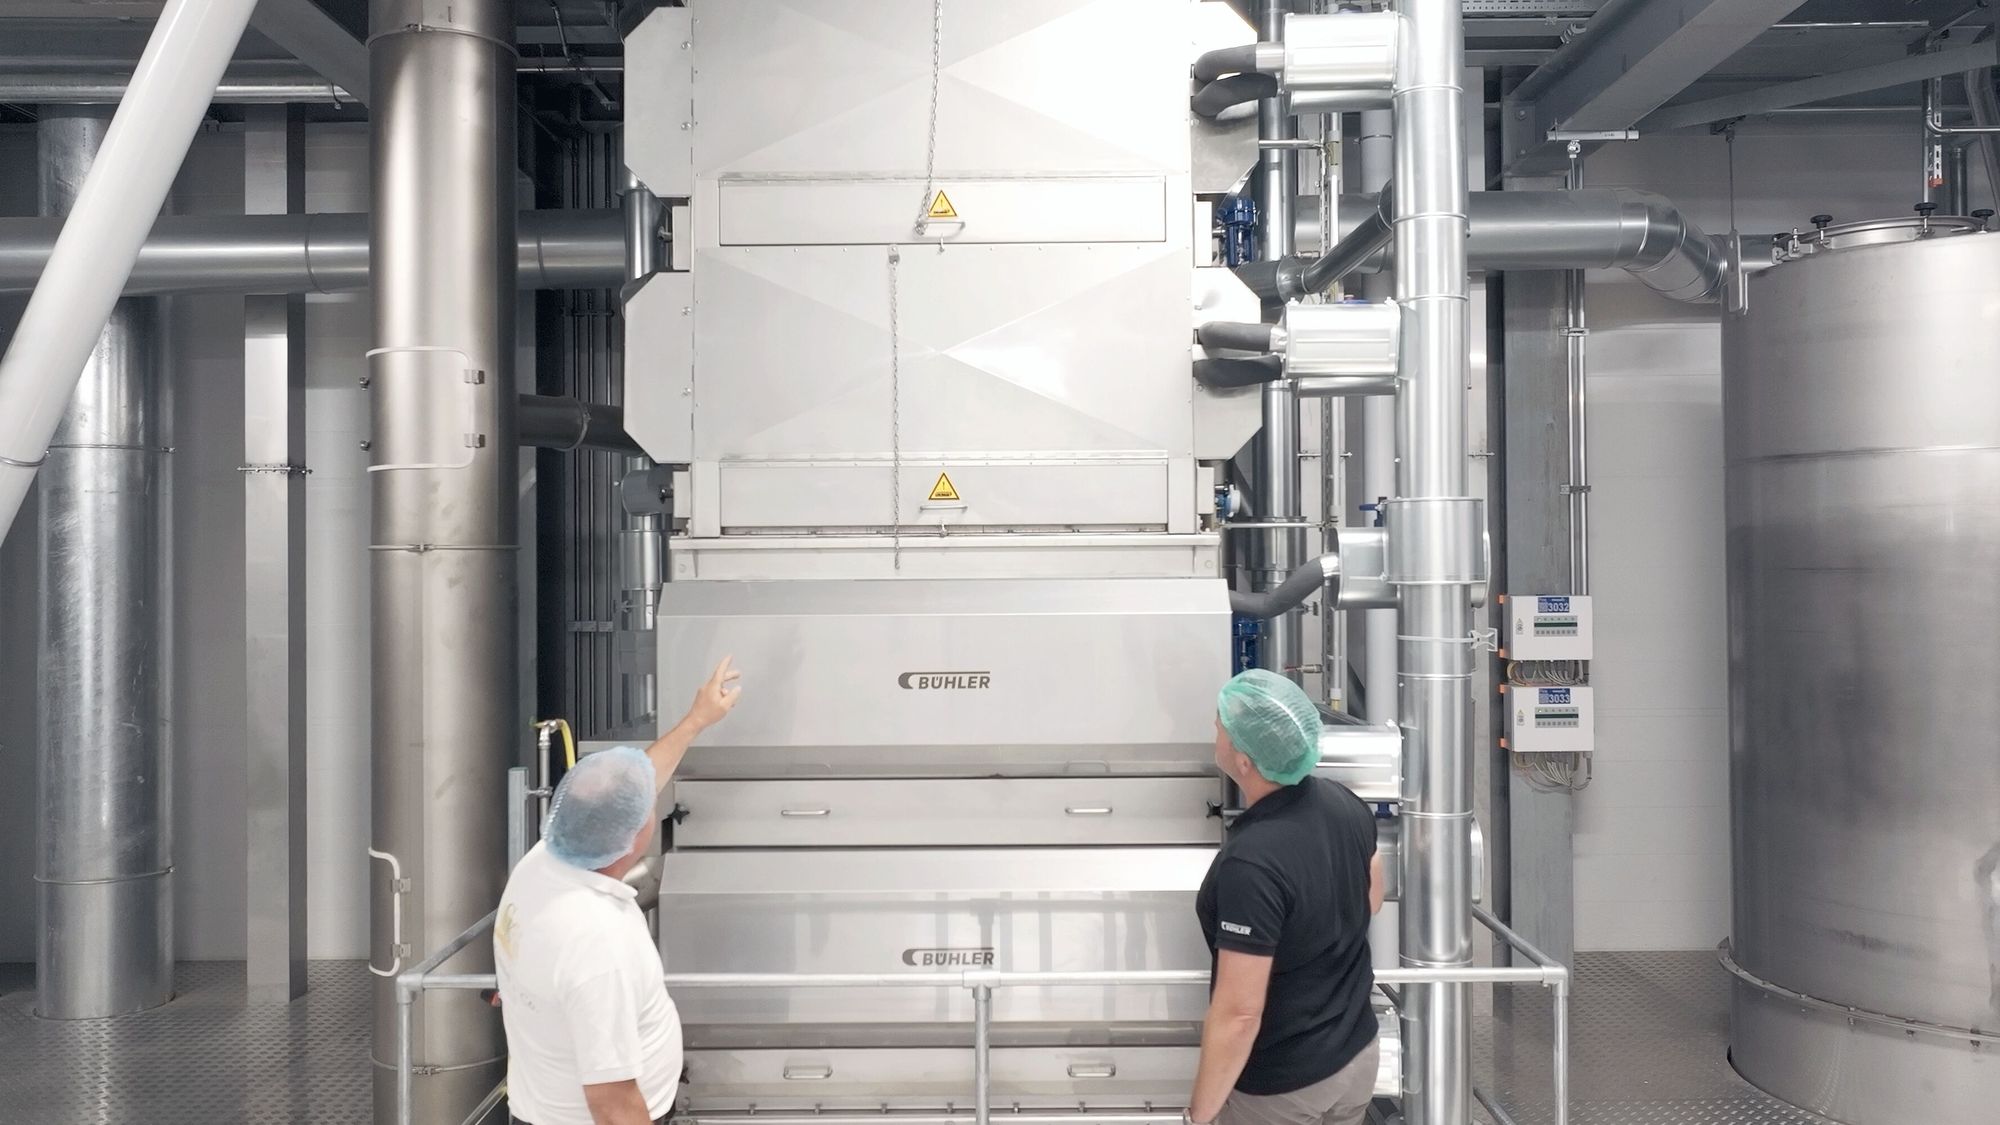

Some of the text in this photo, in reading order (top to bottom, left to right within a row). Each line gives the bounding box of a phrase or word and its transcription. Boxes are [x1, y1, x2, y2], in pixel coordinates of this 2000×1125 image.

[1547, 602, 1569, 612] 3032
[918, 675, 991, 689] BÜHLER
[1549, 693, 1570, 703] 3033
[922, 952, 995, 966] BÜHLER
